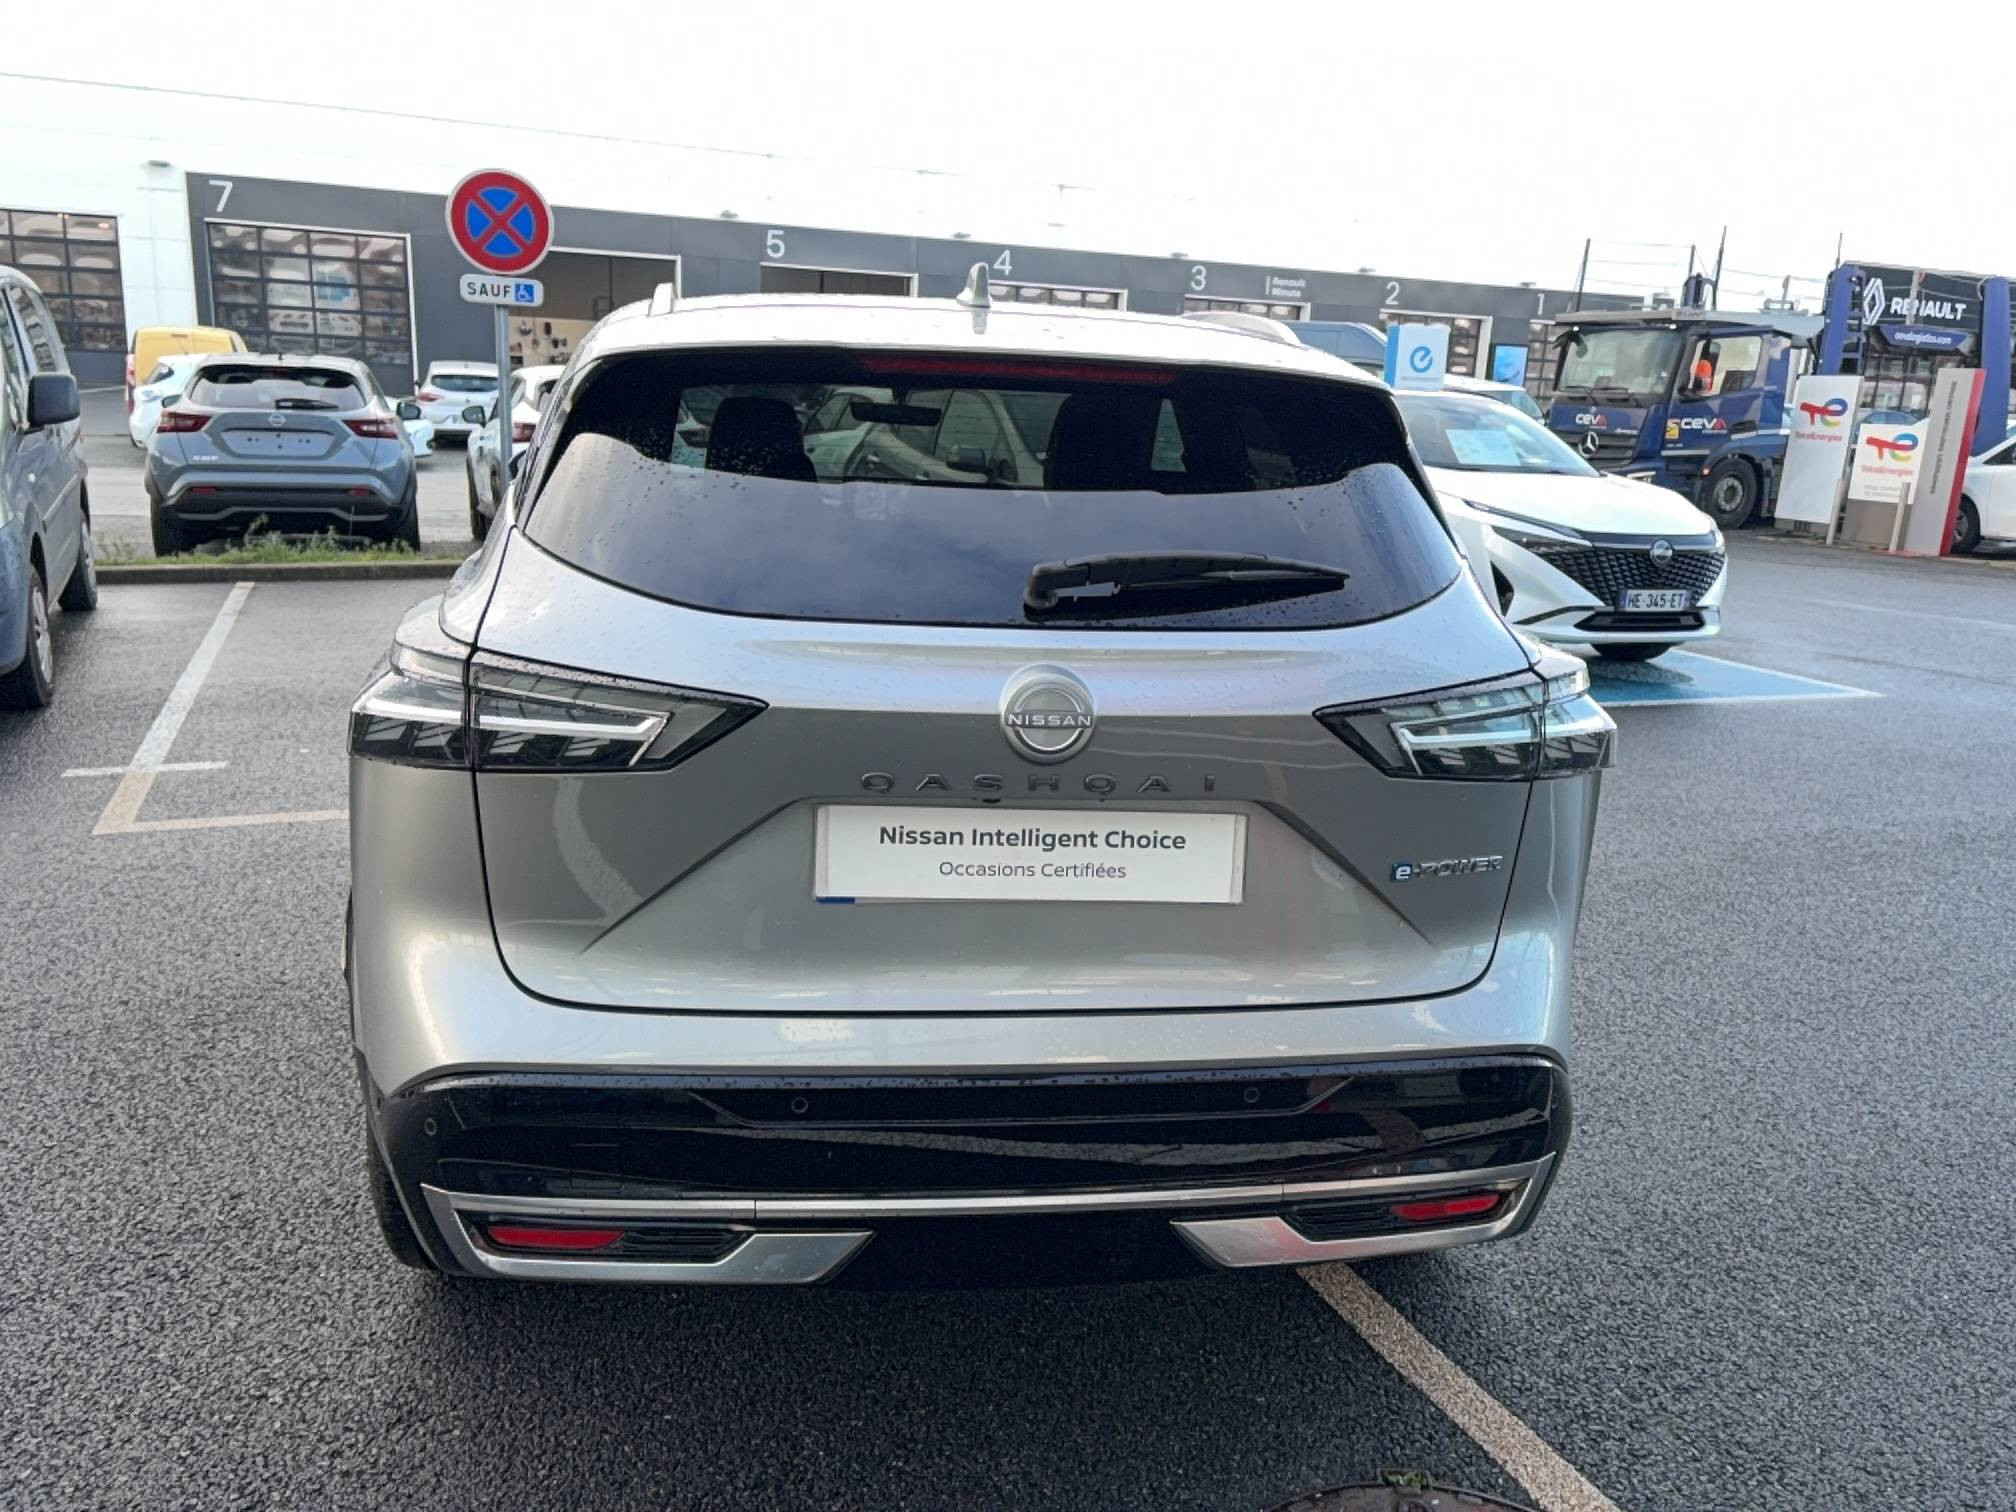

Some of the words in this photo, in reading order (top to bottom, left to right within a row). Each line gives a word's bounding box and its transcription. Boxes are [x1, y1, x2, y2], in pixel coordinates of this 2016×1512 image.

[208, 180, 234, 213] 7
[766, 229, 787, 258] 5
[993, 250, 1014, 276] 4
[467, 281, 512, 299] SAUF
[1190, 265, 1207, 292] 3
[1385, 281, 1400, 305] 2
[1537, 294, 1545, 316] 1
[1890, 297, 1967, 320] RENAULT
[1008, 712, 1093, 728] NISSAN
[861, 772, 1216, 794] QASHQAI
[879, 826, 965, 847] Nissan
[971, 828, 1099, 852] Intelligent
[1105, 830, 1187, 850] Choice
[938, 860, 1036, 877] Occasions
[1040, 860, 1127, 879] Certifiées
[1392, 855, 1503, 880] e-POWER
